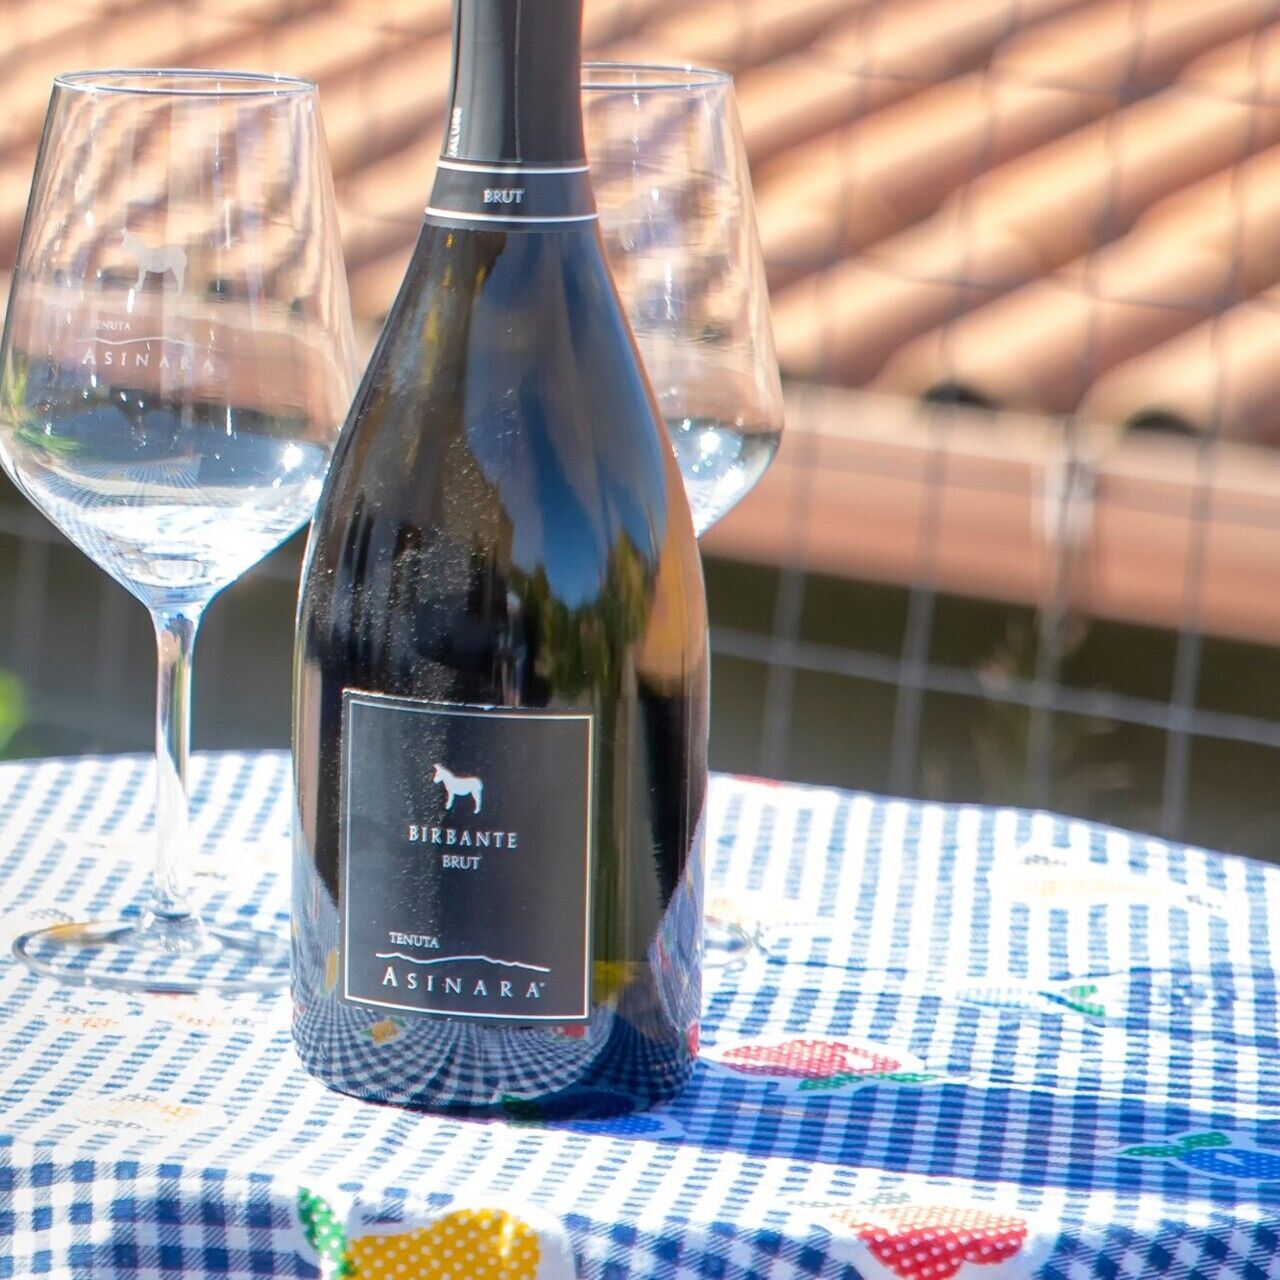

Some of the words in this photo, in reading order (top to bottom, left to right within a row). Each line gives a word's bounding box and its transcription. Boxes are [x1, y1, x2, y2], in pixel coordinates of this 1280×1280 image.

[483, 188, 524, 204] BRUT
[86, 319, 132, 332] NUTA
[81, 347, 215, 375] ASINARA
[408, 824, 518, 849] BIRBANTE
[442, 854, 481, 870] BRUT
[389, 932, 440, 949] TENUTA
[382, 966, 540, 998] ASINARA
